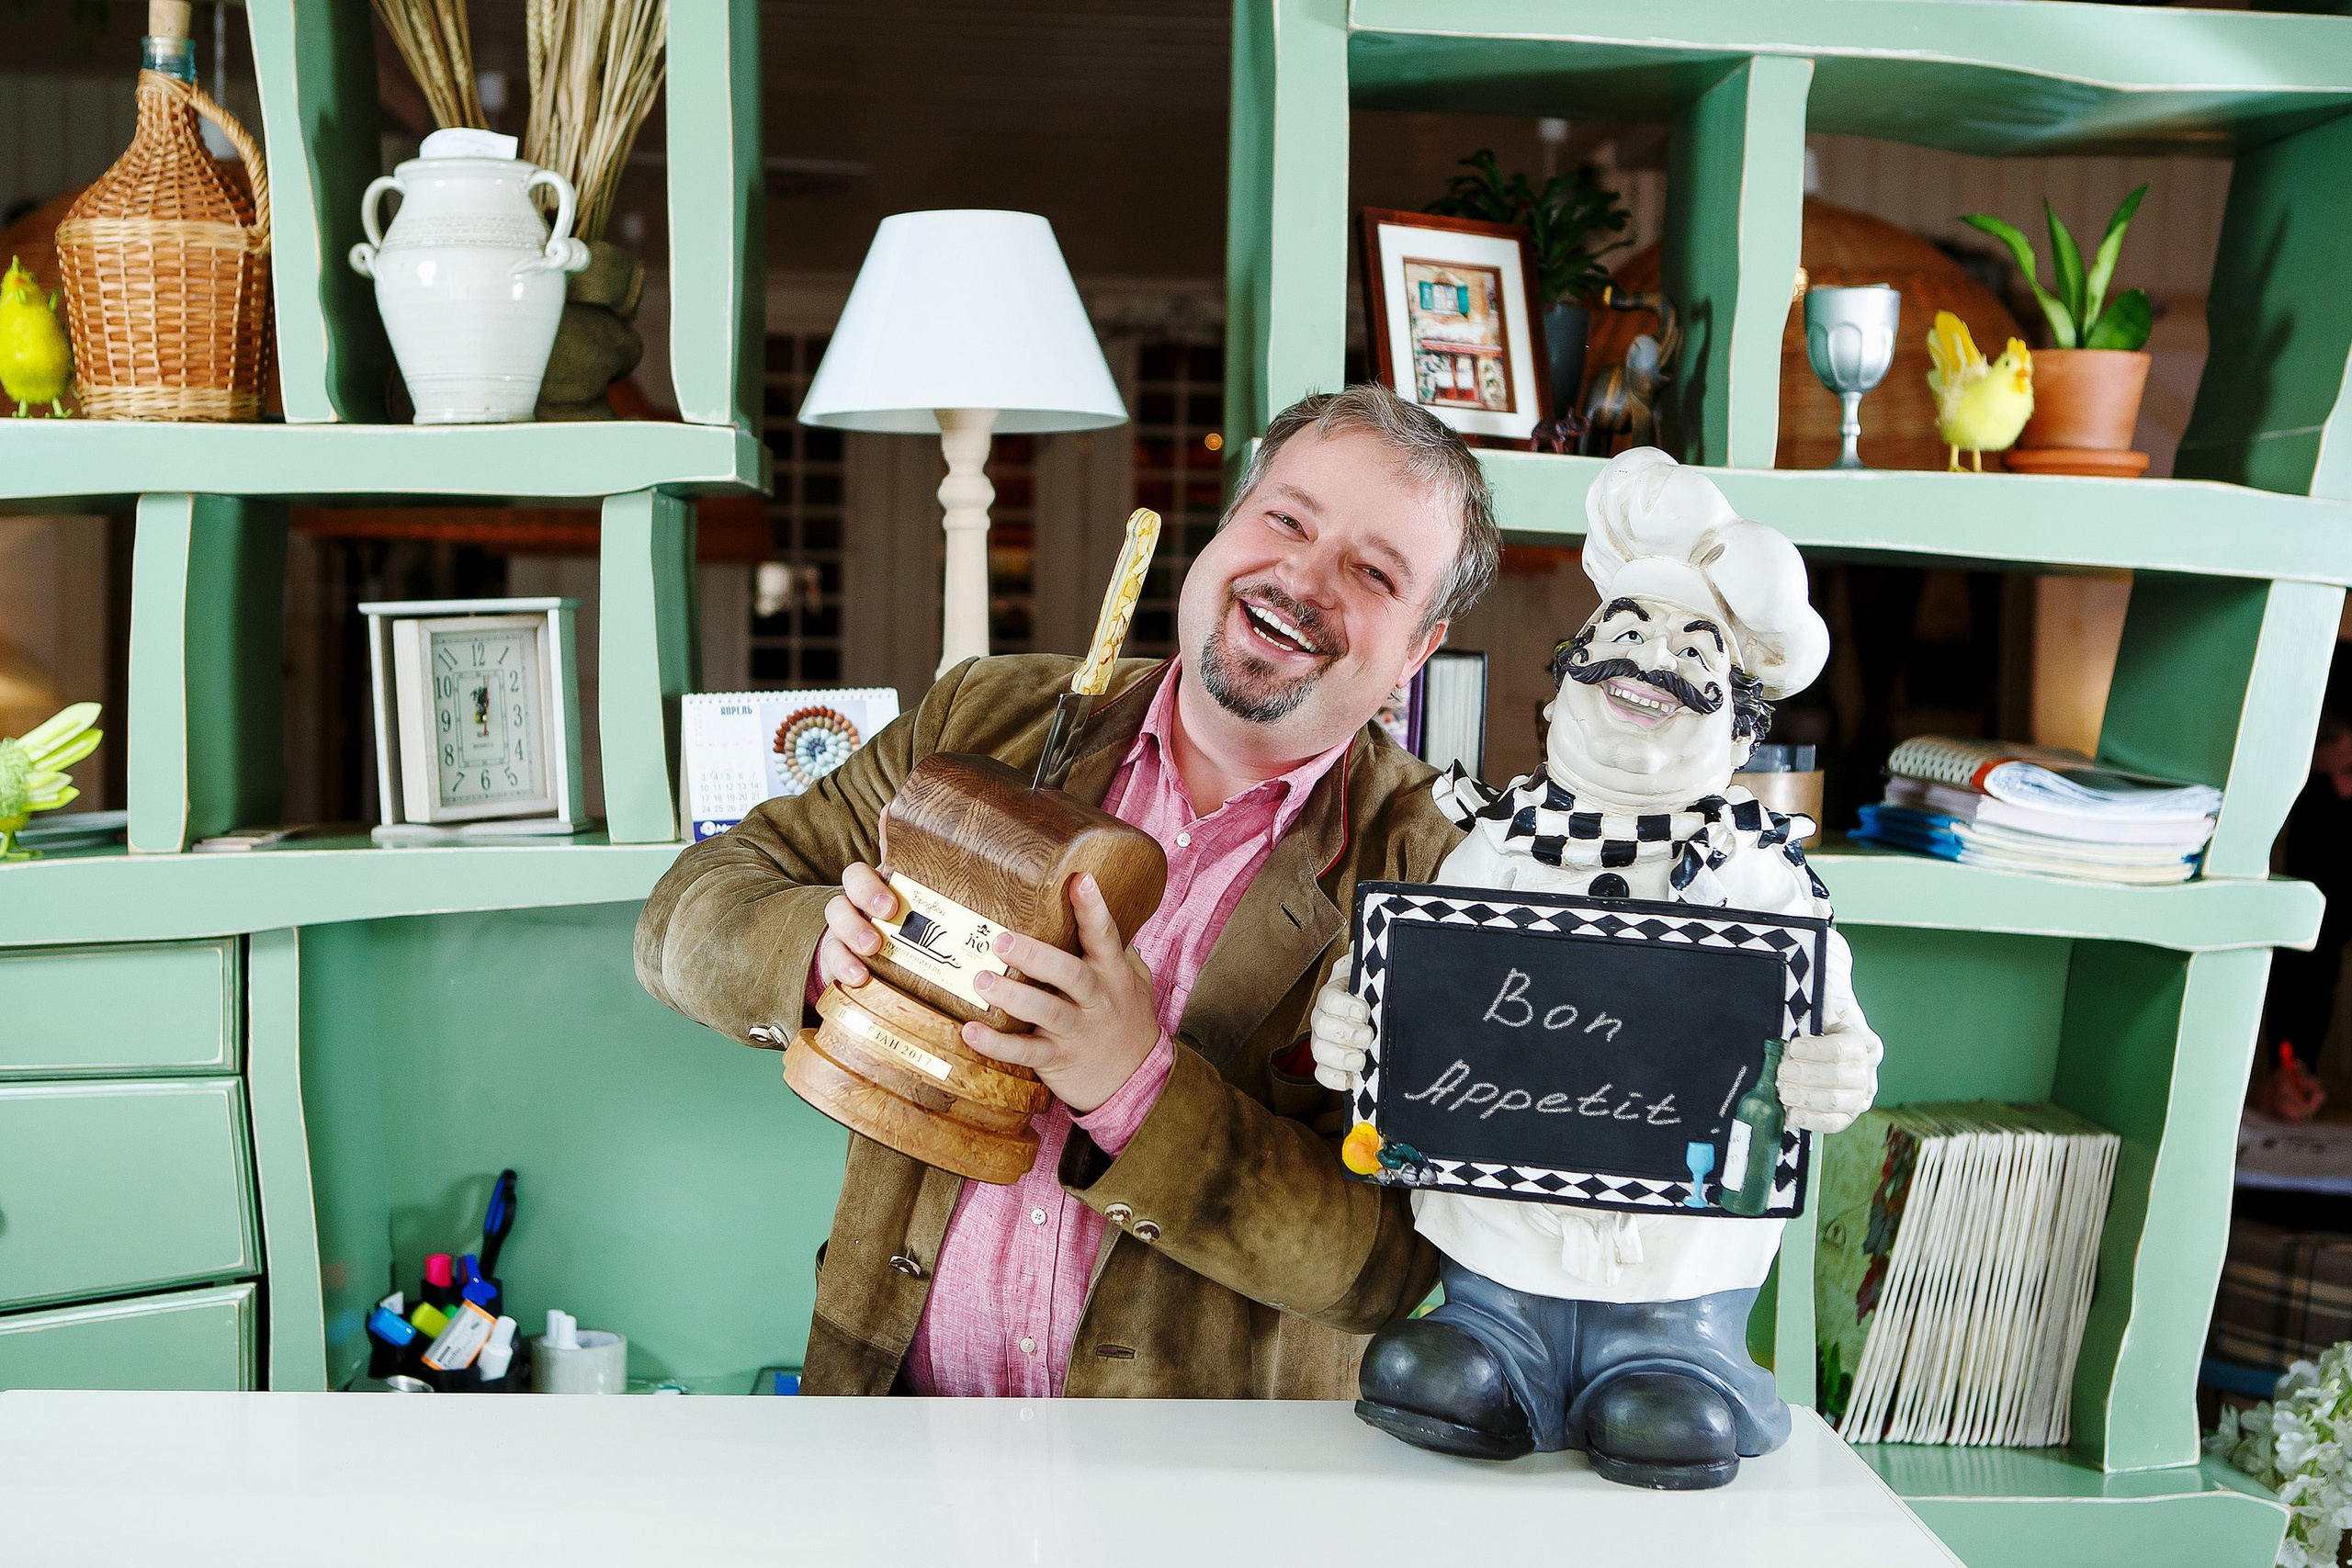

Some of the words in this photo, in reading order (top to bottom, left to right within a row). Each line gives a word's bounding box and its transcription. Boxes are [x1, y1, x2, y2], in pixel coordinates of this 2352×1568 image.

[438, 646, 458, 671] 11
[471, 643, 486, 666] 12
[498, 646, 509, 664] 1
[435, 675, 452, 699] 10
[509, 671, 519, 692] 2
[441, 709, 451, 732] 9
[513, 705, 523, 728] 3
[720, 705, 753, 716] АПРЕЛЬ
[444, 744, 455, 766] 8
[514, 739, 524, 761] 4
[452, 772, 466, 793] 7
[481, 769, 491, 790] 6
[504, 767, 518, 786] 5
[714, 784, 721, 792] 11
[751, 782, 759, 790] 14
[701, 795, 710, 803] 17
[739, 793, 747, 801] 20
[702, 806, 711, 814] 24
[714, 805, 724, 813] 25
[740, 804, 748, 812] 27
[1483, 967, 1623, 1042] Bon
[900, 1045, 933, 1066] 2017
[1404, 1059, 1681, 1125] Appetit
